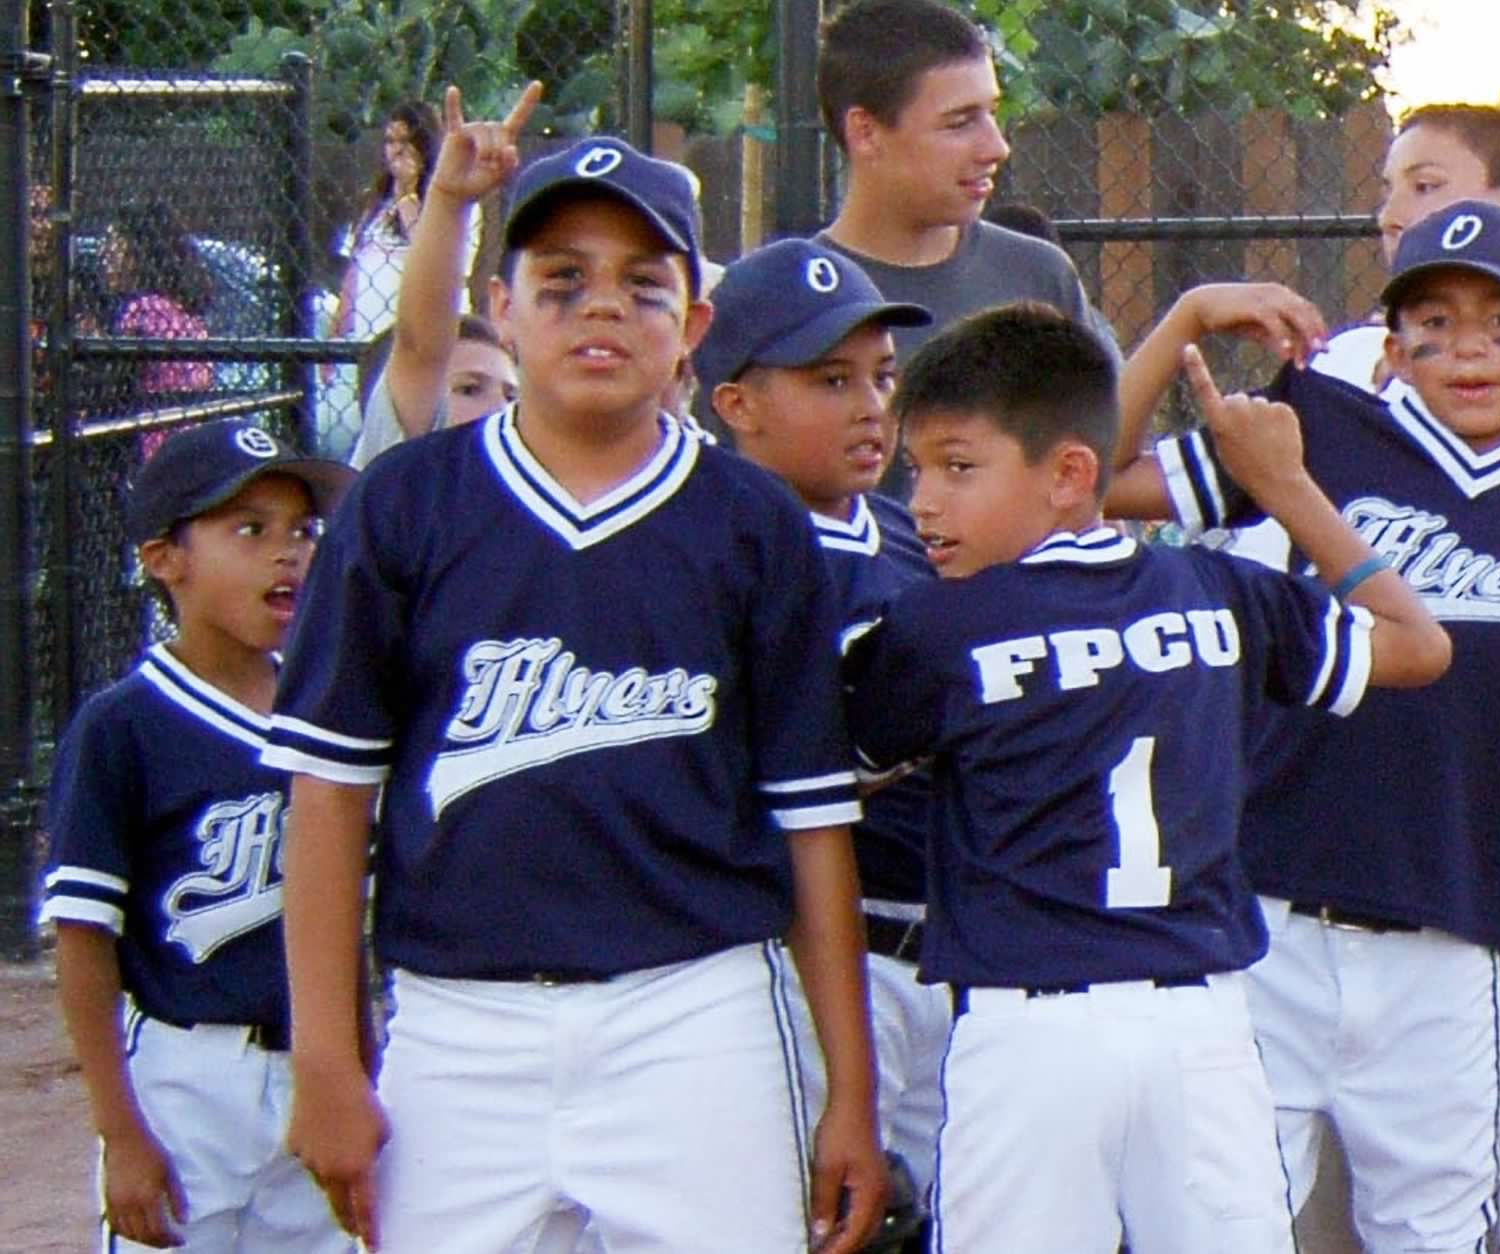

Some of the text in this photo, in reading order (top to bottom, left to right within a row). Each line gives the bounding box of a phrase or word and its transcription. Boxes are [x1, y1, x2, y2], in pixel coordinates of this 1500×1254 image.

[575, 146, 622, 178] O
[1442, 214, 1483, 250] O
[807, 257, 839, 292] O
[971, 608, 1241, 704] FPCU
[445, 637, 718, 752] Flyers
[1106, 736, 1172, 908] 1
